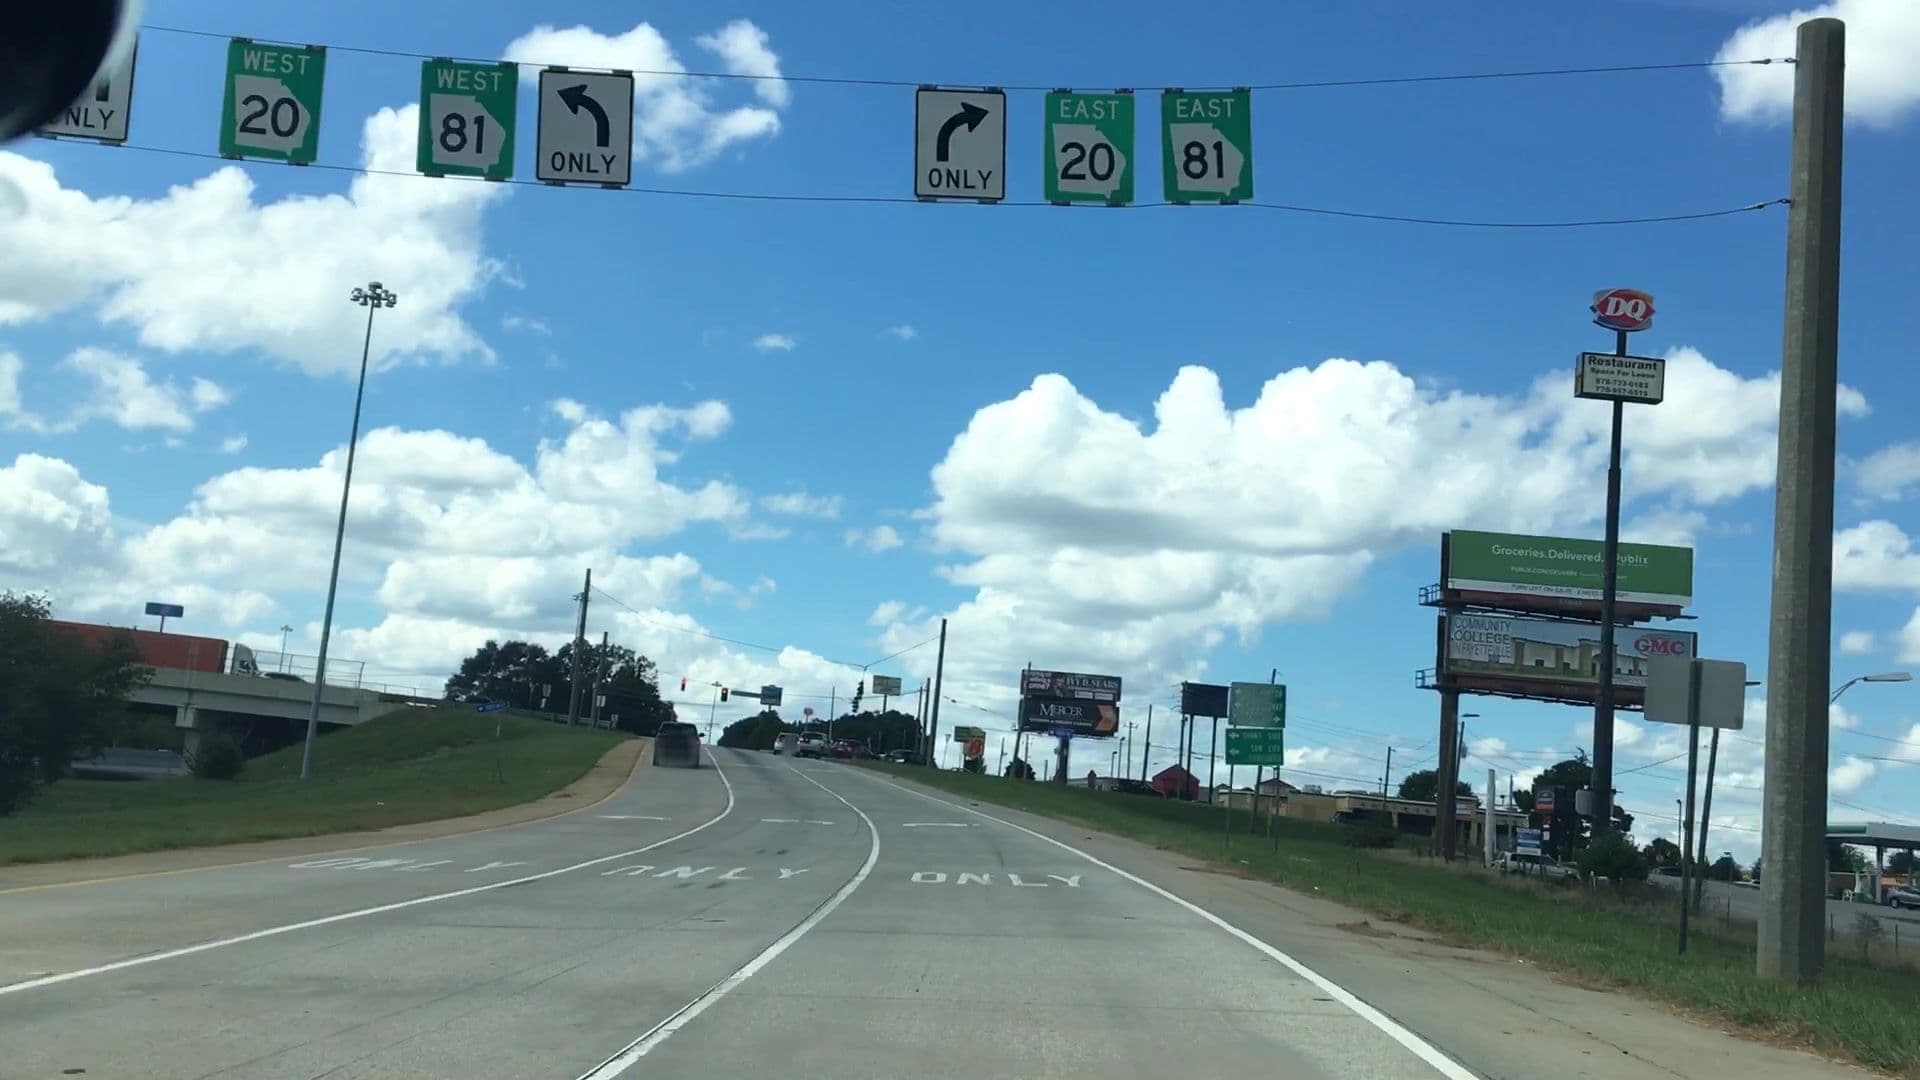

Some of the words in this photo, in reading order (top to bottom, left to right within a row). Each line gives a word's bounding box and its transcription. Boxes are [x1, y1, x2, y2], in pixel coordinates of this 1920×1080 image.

[243, 48, 311, 75] WEST
[437, 68, 503, 92] WEST
[56, 106, 115, 130] NLY
[240, 94, 300, 137] 20
[1060, 99, 1120, 119] EAST
[1176, 98, 1235, 118] EAST
[439, 112, 485, 154] 81
[551, 151, 616, 174] ONLY
[1060, 142, 1115, 181] 20
[1182, 141, 1224, 179] 81
[928, 167, 993, 189] ONLY
[1604, 296, 1647, 321] DQ
[1588, 355, 1657, 370] Restaurant
[1455, 616, 1512, 632] COMMUNITY
[1453, 629, 1512, 646] COLLEGE
[1633, 637, 1687, 656] GMC
[600, 865, 810, 880] ONLY
[911, 871, 1083, 888] ONLY
